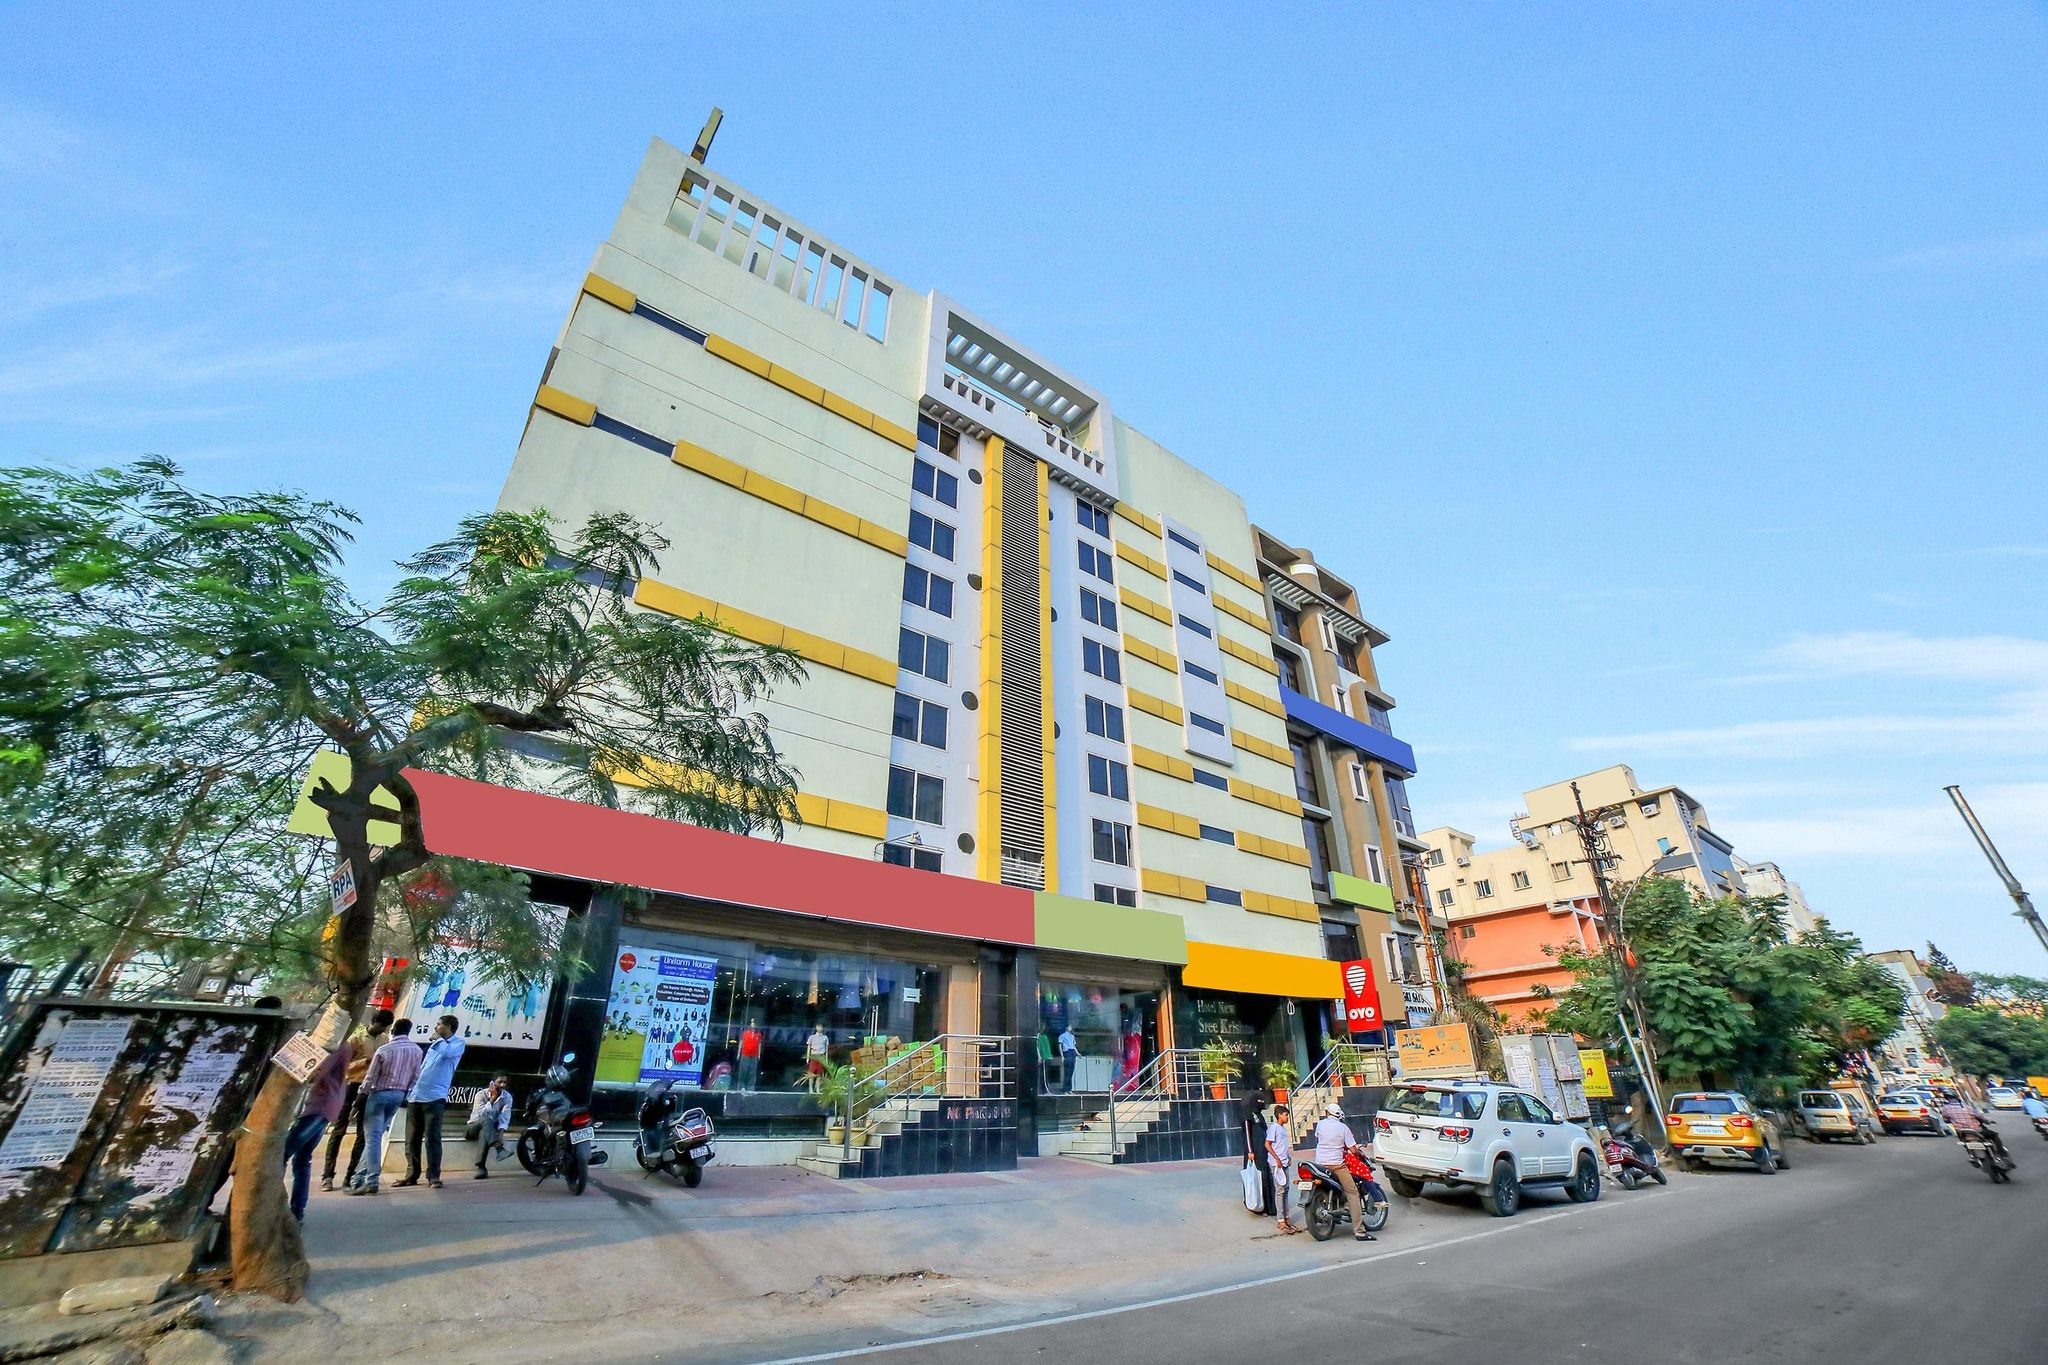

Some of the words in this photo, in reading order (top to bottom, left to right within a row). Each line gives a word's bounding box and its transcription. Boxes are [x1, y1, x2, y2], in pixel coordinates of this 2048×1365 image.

[333, 870, 353, 899] RPA
[663, 956, 690, 967] Uniform
[692, 959, 713, 969] House
[1197, 999, 1216, 1013] Hotel
[1349, 1006, 1375, 1020] OYO
[1197, 1017, 1218, 1033] Sree
[51, 1056, 89, 1064] GENUINE
[38, 1080, 99, 1088] 9133031229
[20, 1117, 83, 1126] 9133031229
[11, 1129, 54, 1138] GENUINE
[56, 1128, 77, 1136] JOBS
[1411, 1133, 1419, 1141] 9
